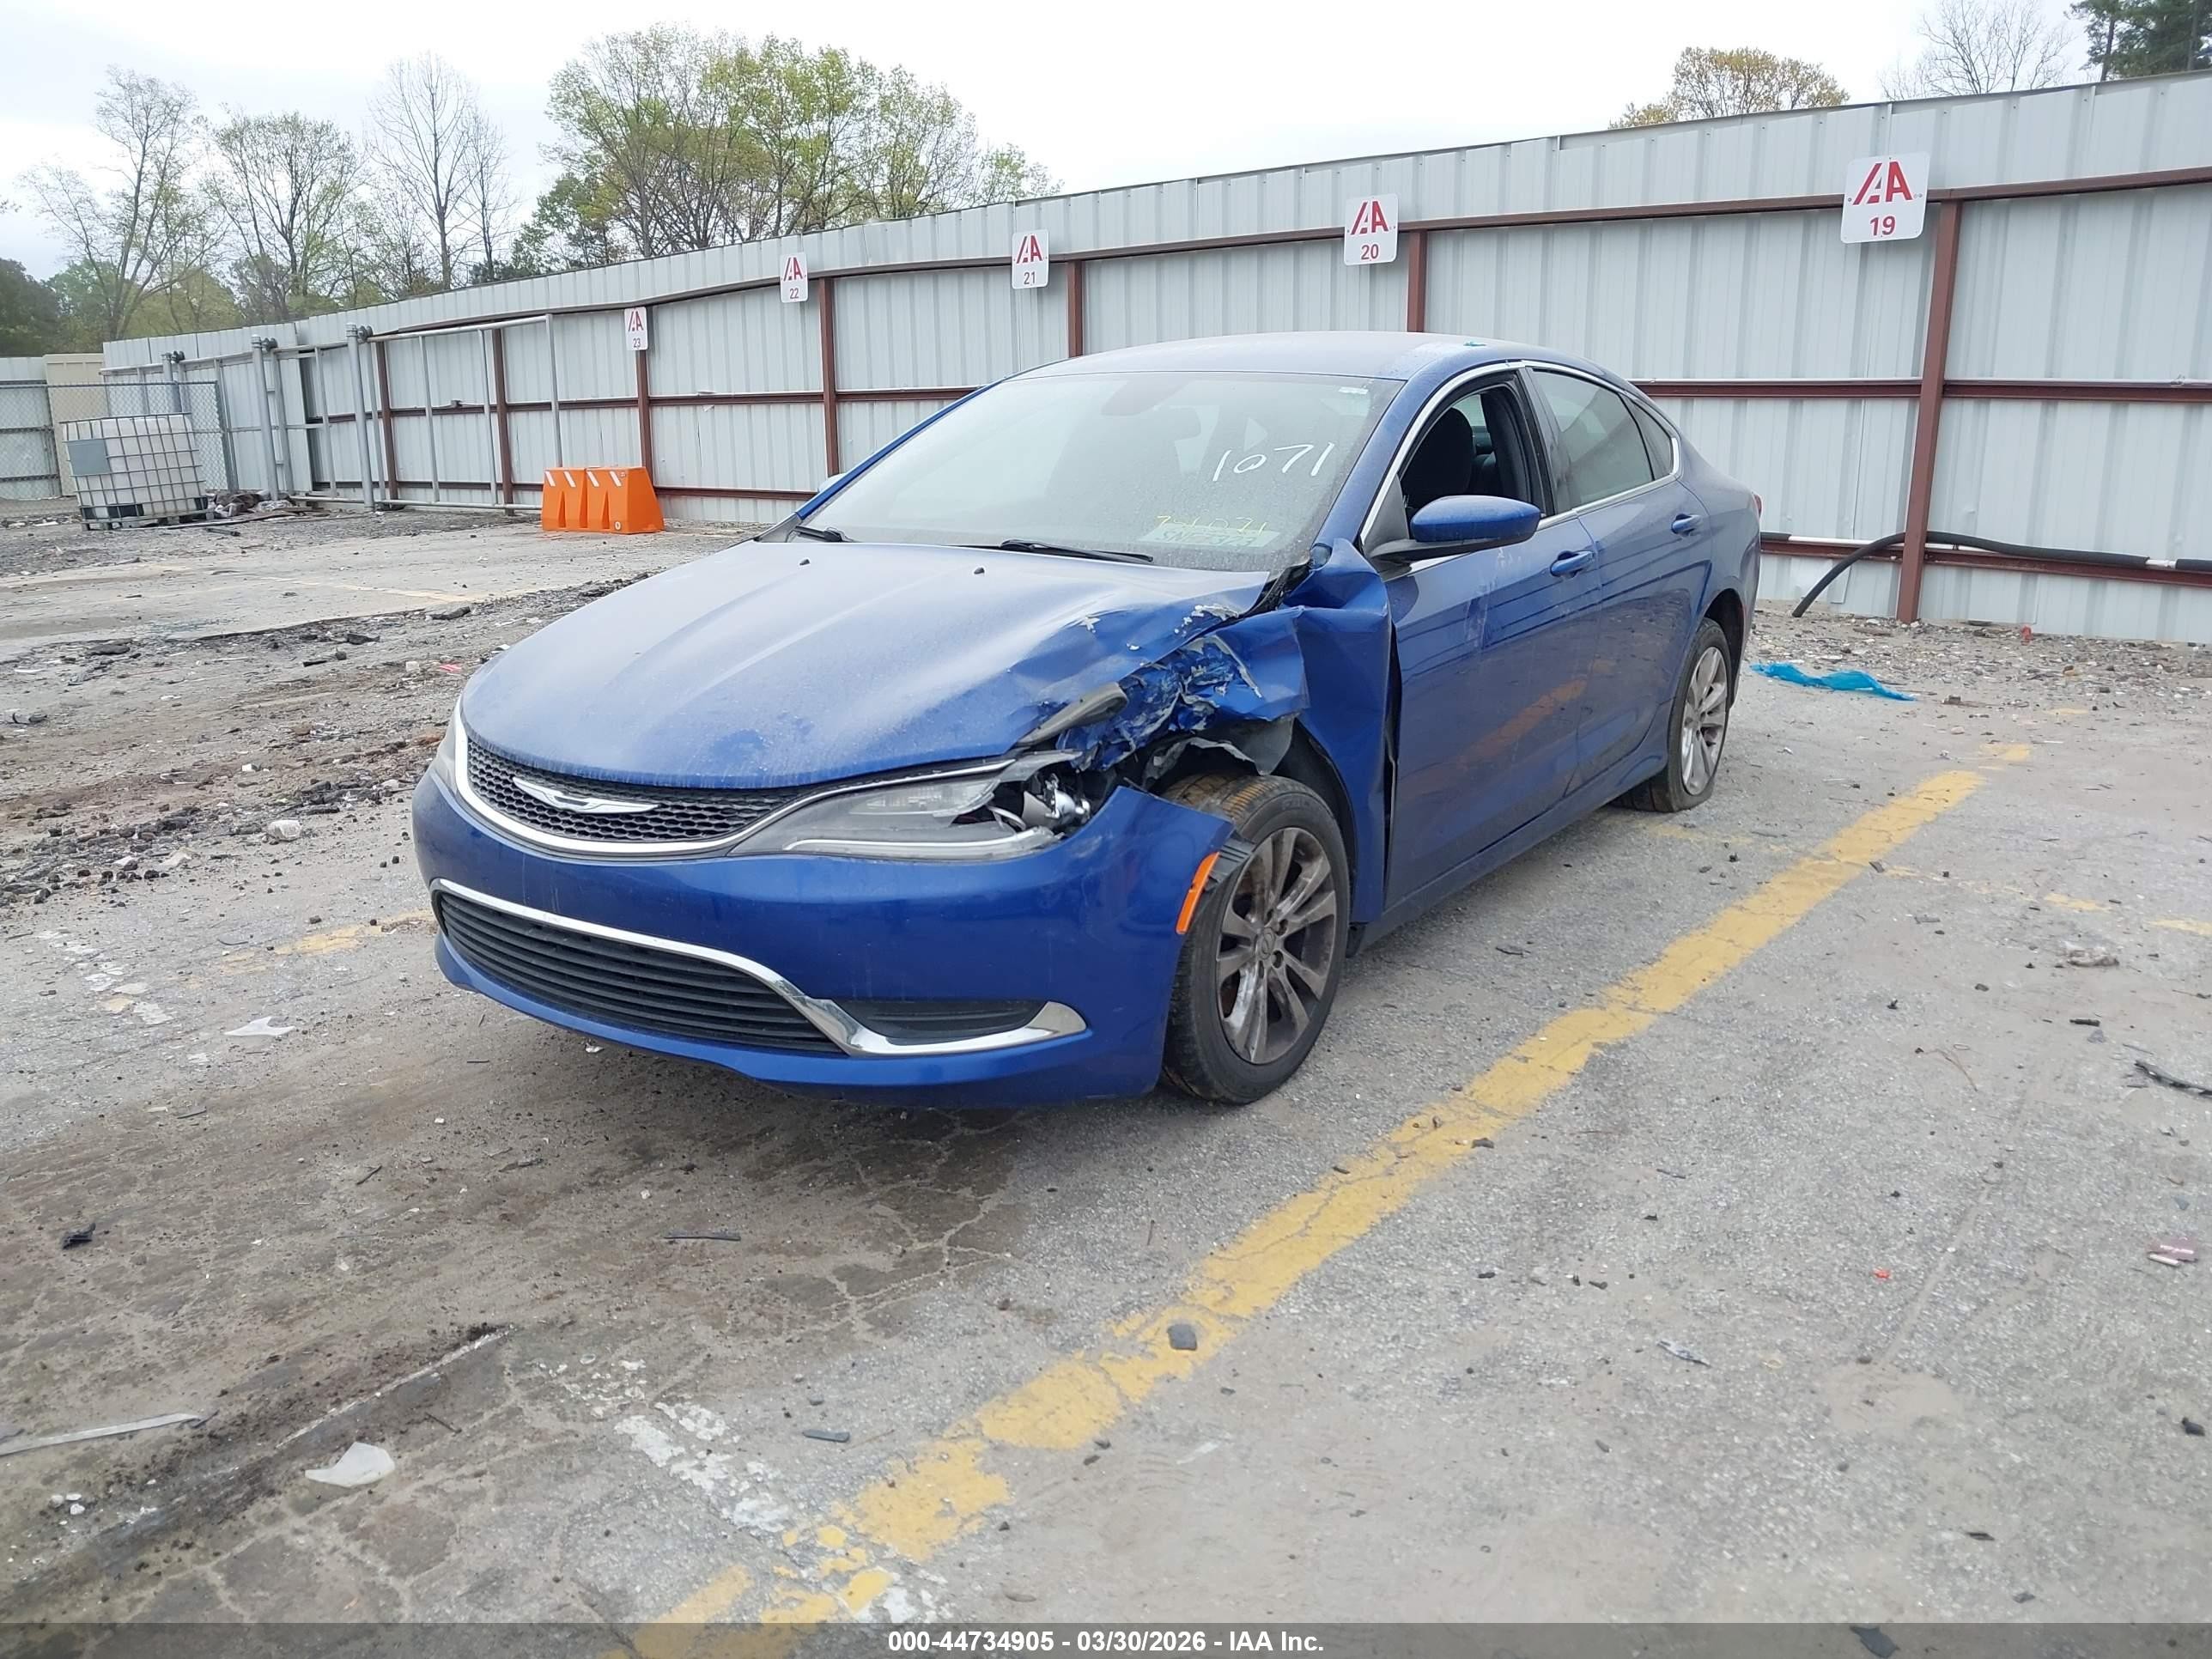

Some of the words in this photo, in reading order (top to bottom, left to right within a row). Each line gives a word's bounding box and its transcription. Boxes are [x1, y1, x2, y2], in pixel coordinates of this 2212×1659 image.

[1870, 216, 1896, 236] 19
[1361, 244, 1379, 259] 20
[1024, 271, 1036, 285] 21
[789, 287, 799, 300] 22
[633, 337, 641, 349] 23
[1212, 441, 1335, 482] 1071
